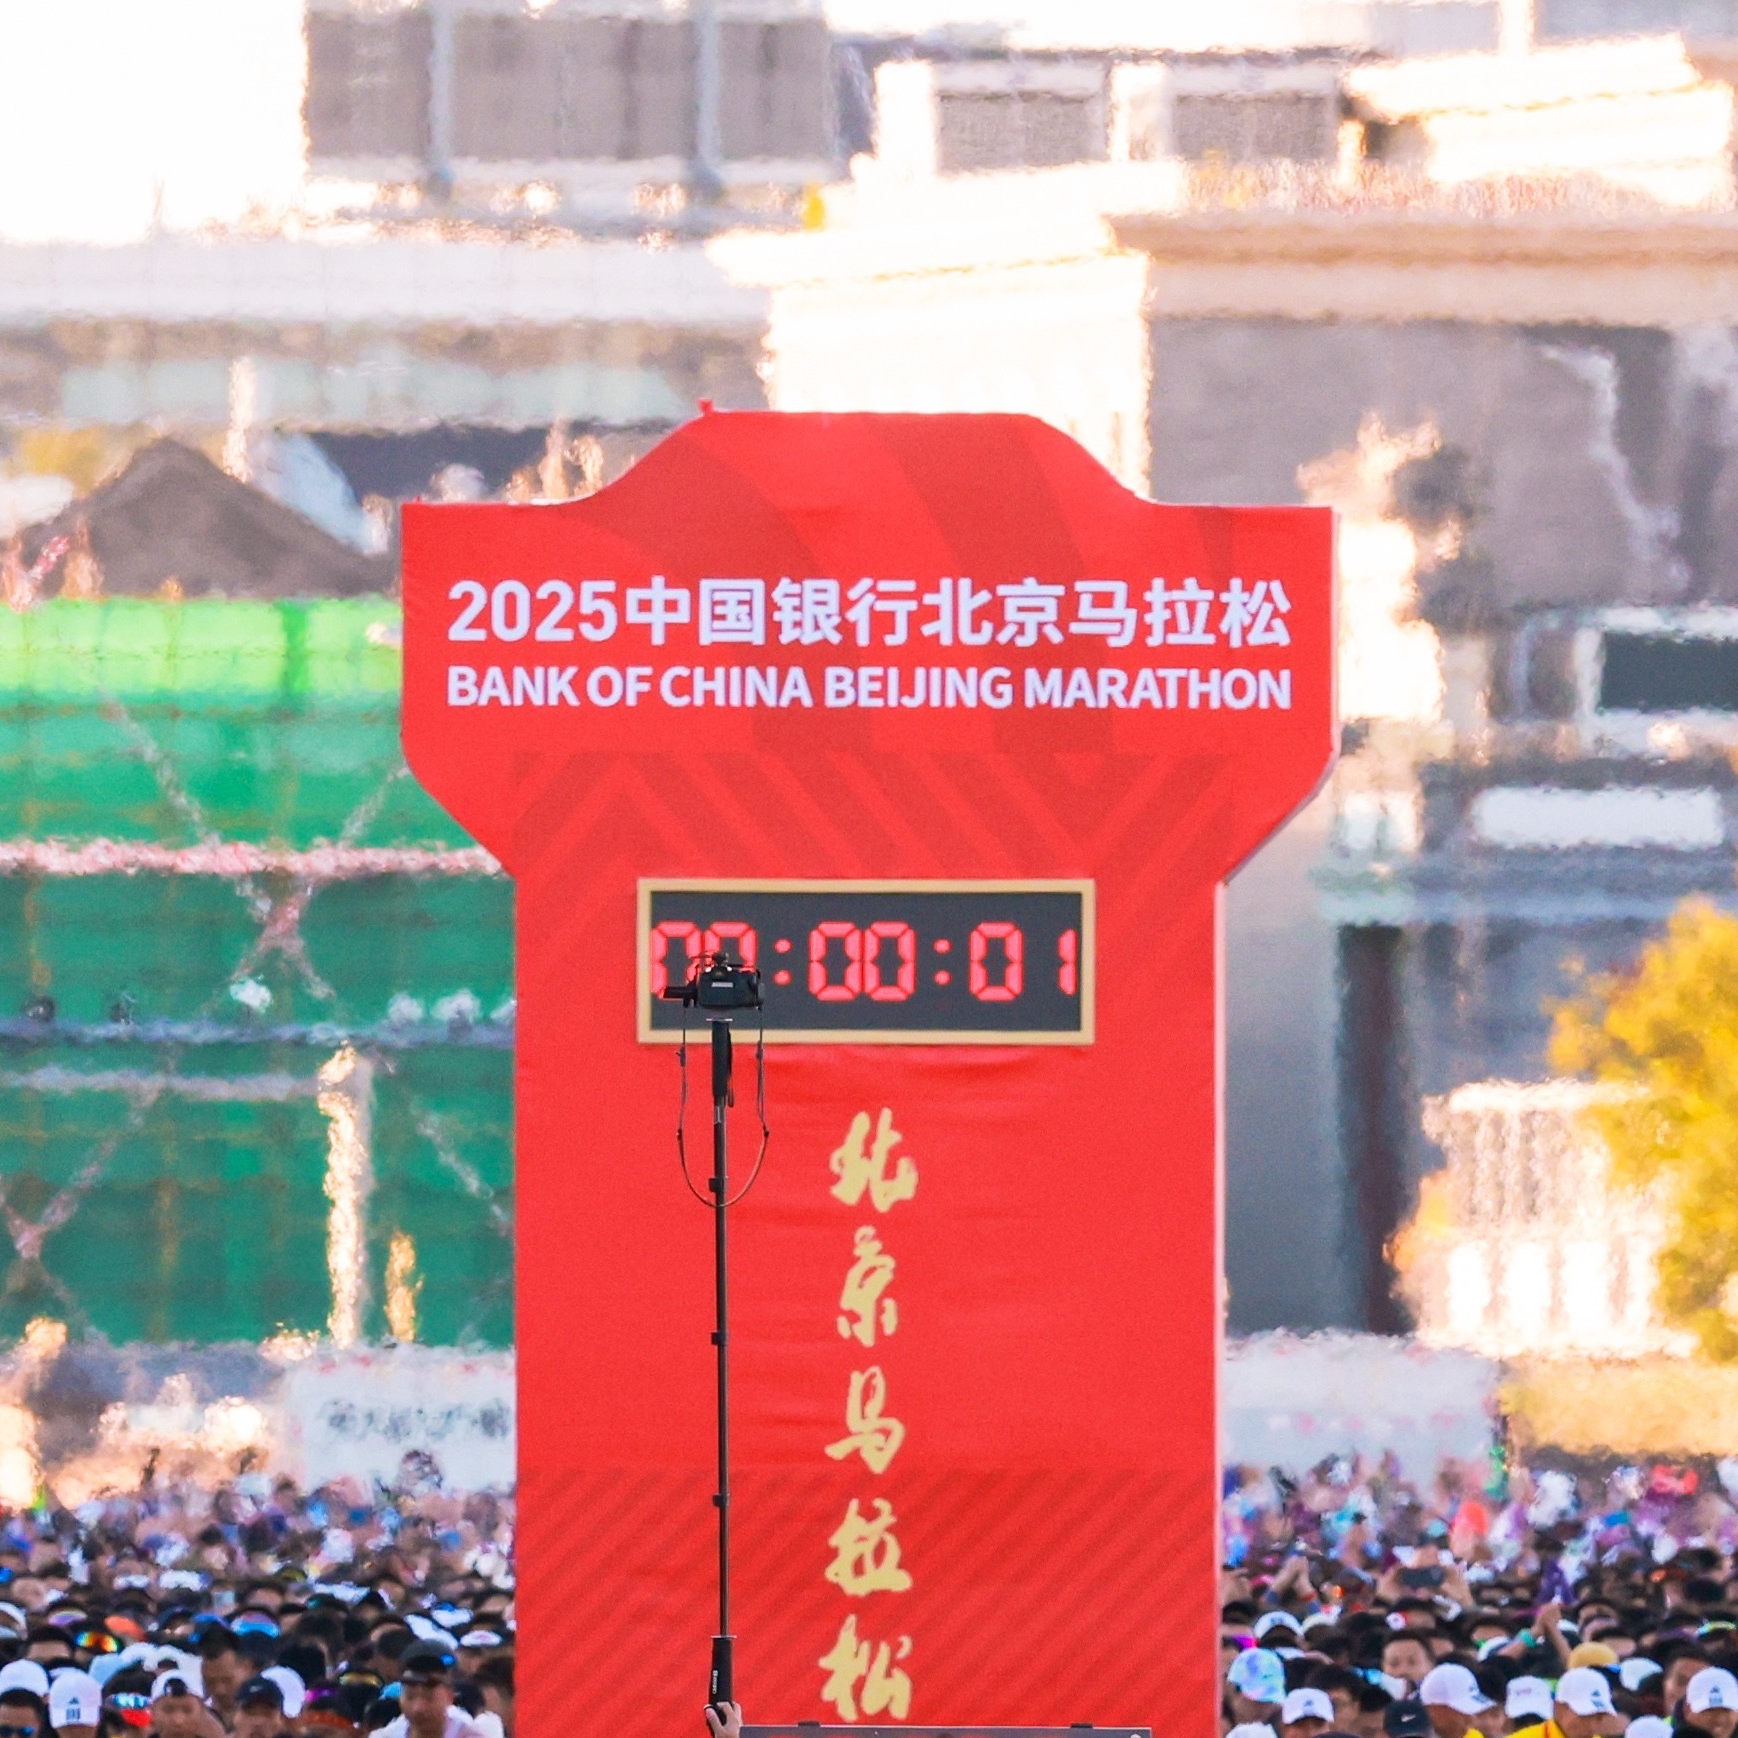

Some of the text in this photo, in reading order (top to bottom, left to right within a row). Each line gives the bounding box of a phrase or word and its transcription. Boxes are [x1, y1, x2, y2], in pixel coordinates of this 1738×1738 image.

[448, 575, 1292, 648] 2025中国银行北京马拉松
[447, 666, 1292, 709] BANK OF CHINA BEIJING MARATHON
[818, 1106, 919, 1722] 北京马拉松
